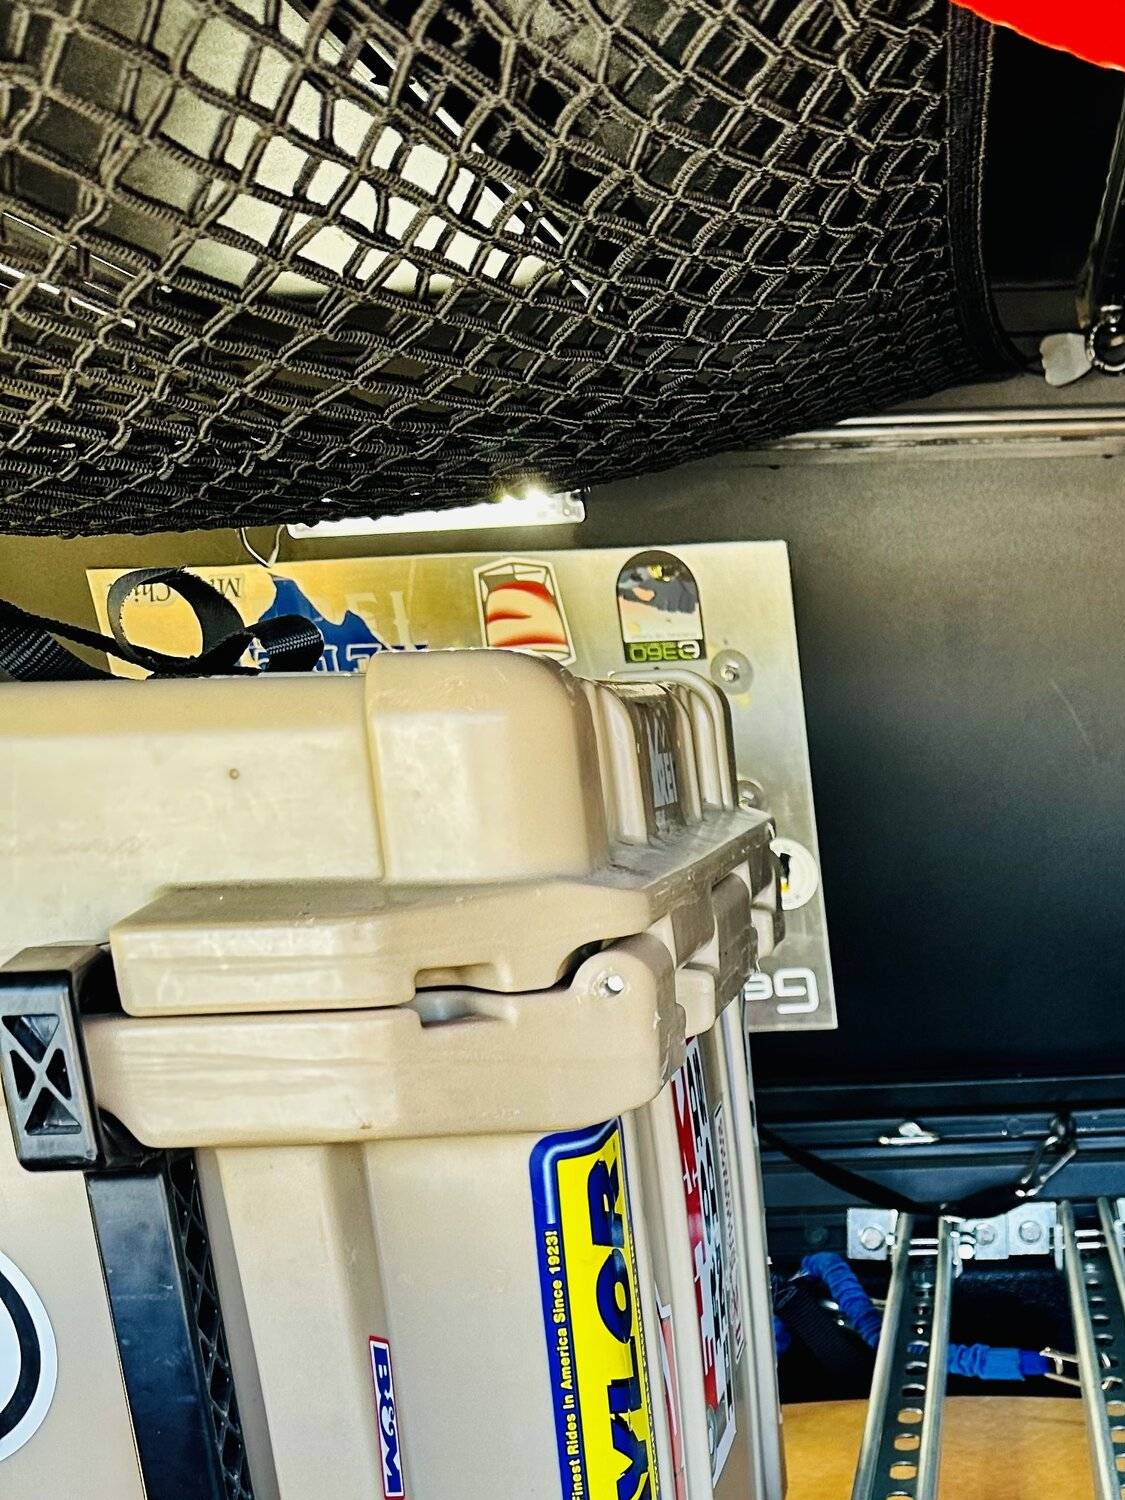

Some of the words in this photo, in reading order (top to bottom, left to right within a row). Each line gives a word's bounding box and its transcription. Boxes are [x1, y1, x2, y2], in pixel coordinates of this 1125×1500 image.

[544, 1230, 562, 1275] 1923!
[552, 1279, 566, 1324] Since
[556, 1327, 573, 1390] America
[372, 1344, 402, 1494] B&M
[562, 1394, 576, 1410] In
[565, 1412, 580, 1456] Rides
